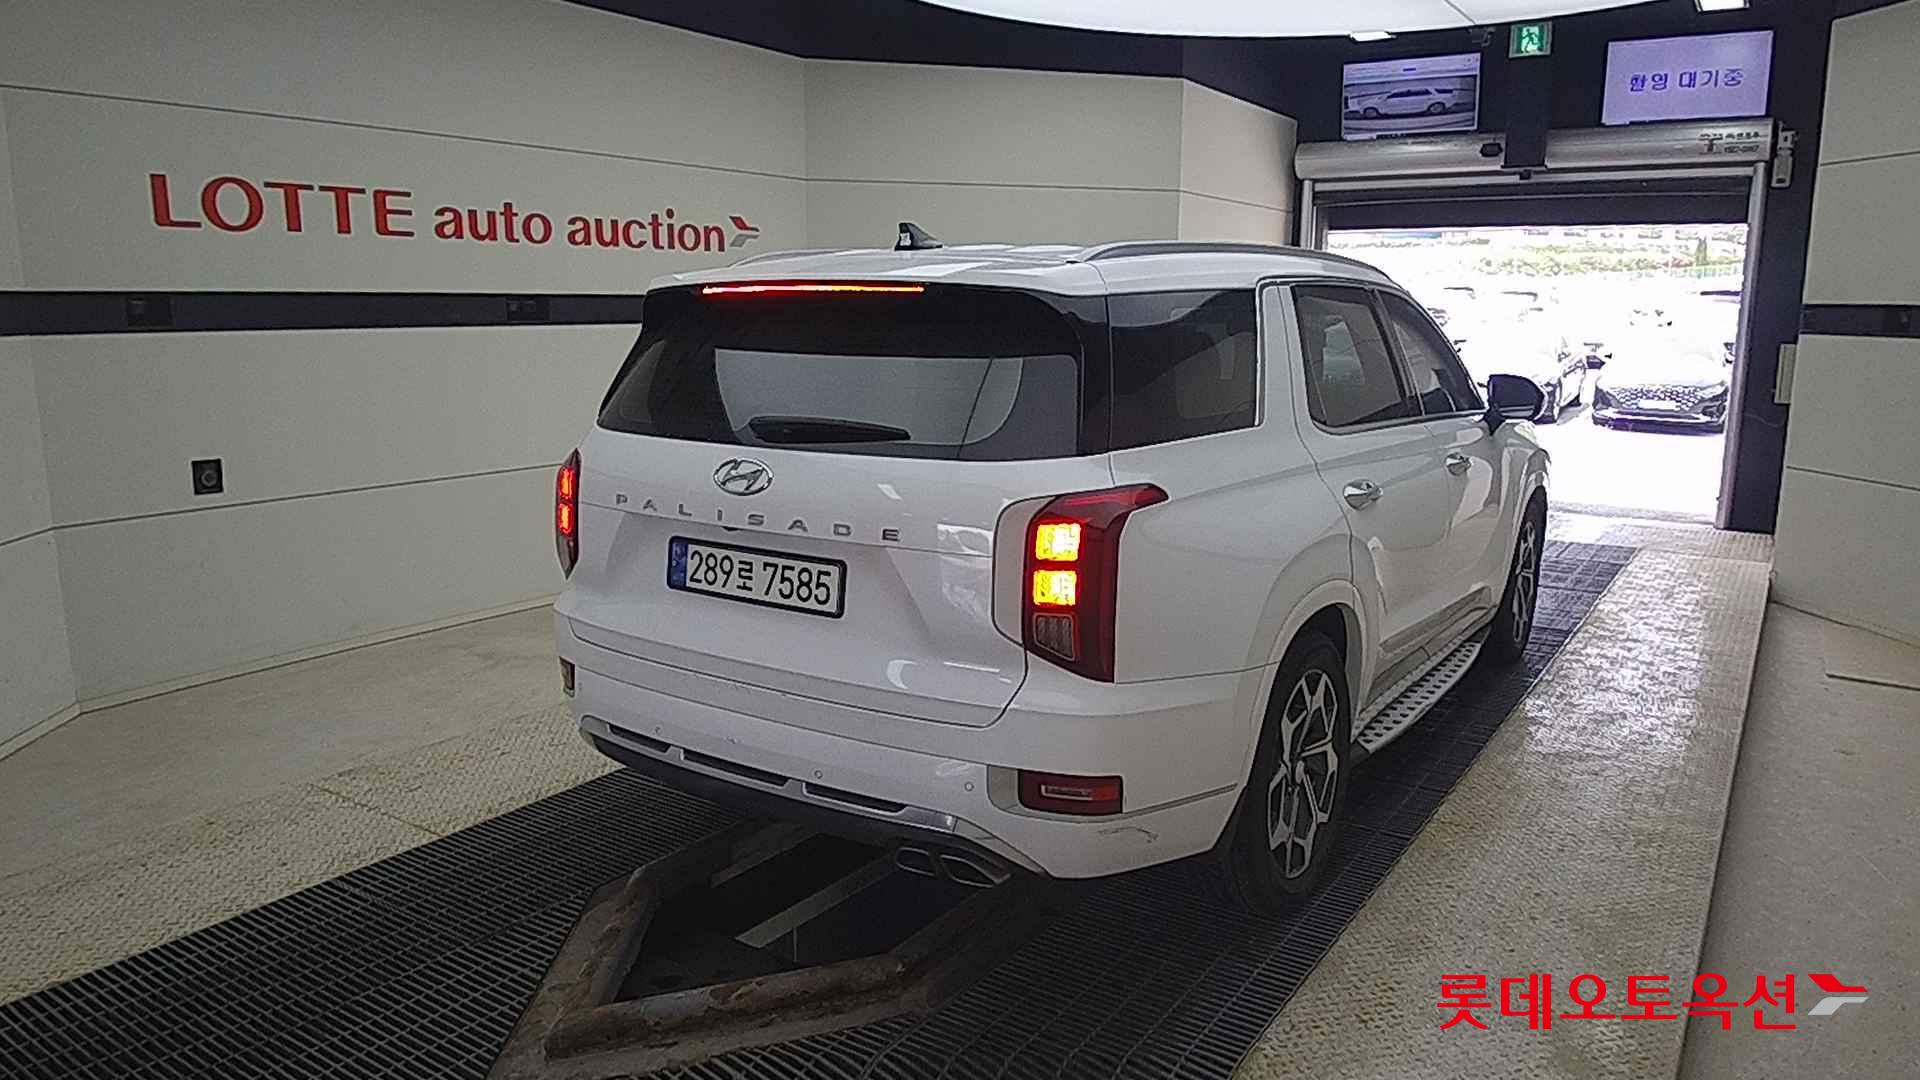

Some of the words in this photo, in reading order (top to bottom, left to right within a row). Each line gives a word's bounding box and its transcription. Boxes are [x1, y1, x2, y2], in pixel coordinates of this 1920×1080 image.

[1678, 67, 1743, 88] 대기중
[149, 173, 415, 237] LOTTE
[434, 202, 552, 245] auto
[567, 208, 725, 252] auction
[614, 493, 902, 542] PALISADE
[688, 550, 754, 592] 289로
[761, 561, 832, 605] 7585
